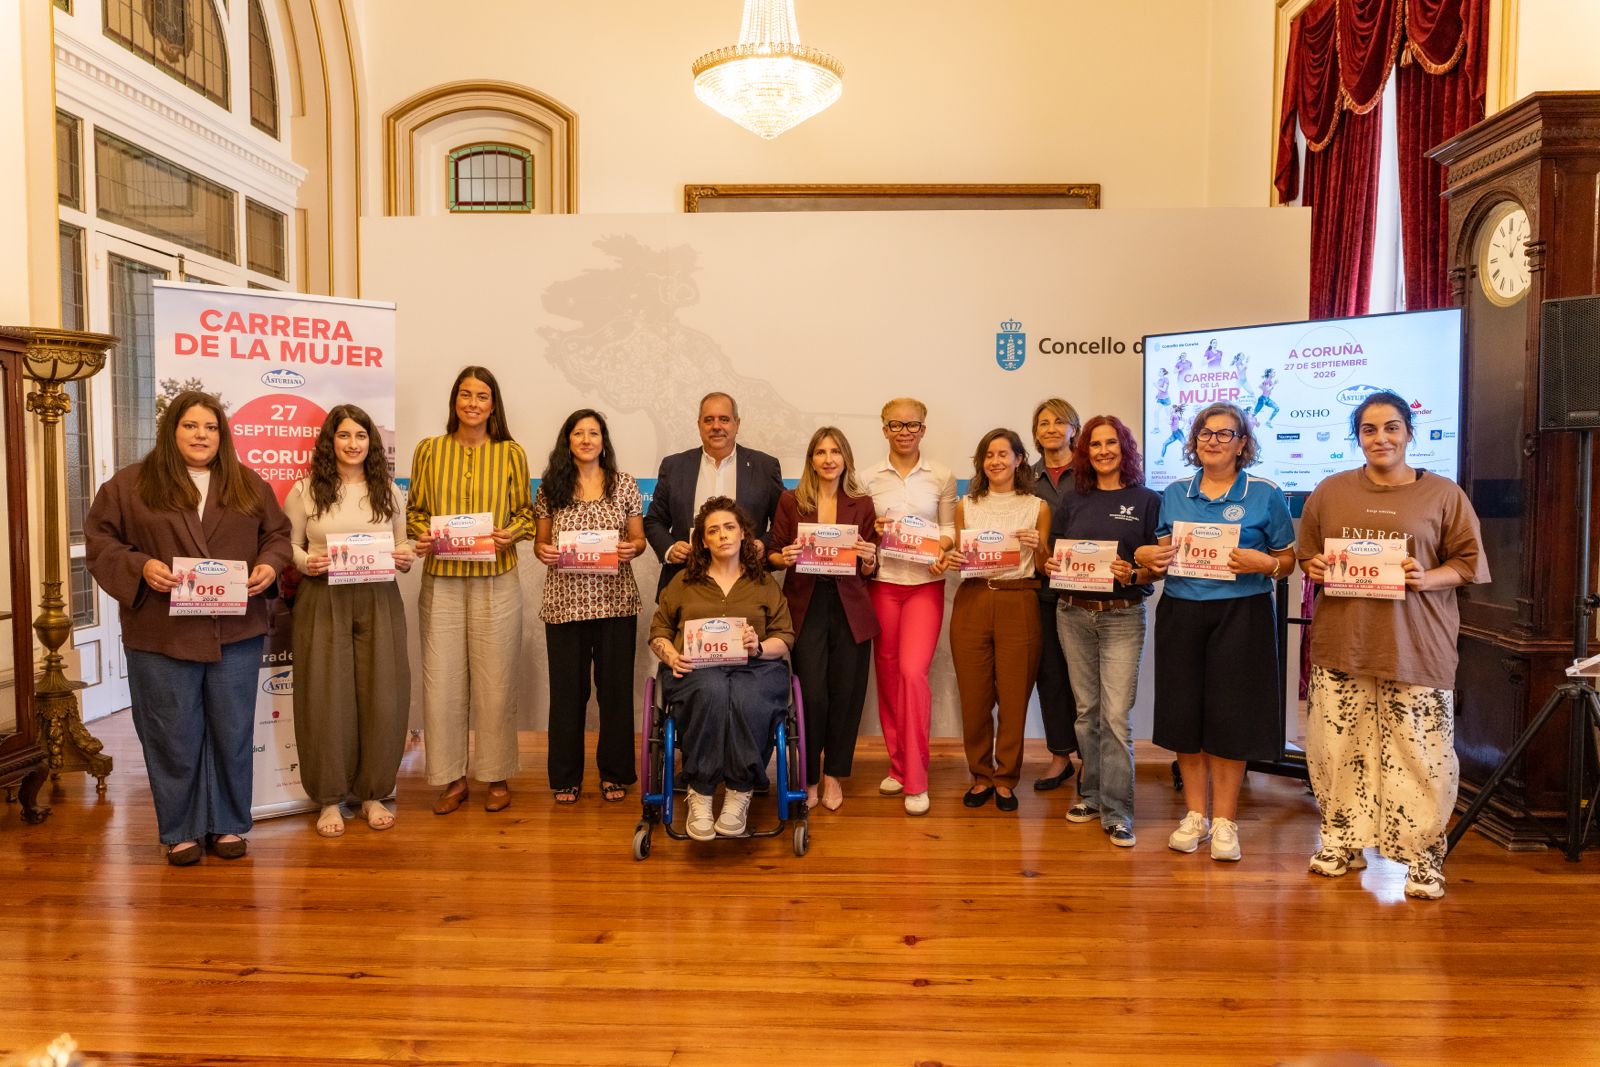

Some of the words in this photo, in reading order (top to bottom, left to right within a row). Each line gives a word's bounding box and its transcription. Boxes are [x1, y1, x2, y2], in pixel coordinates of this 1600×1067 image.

[200, 309, 353, 342] CARRERA
[175, 333, 219, 357] DE
[231, 337, 270, 361] LA
[280, 341, 383, 368] MUJER
[1038, 336, 1126, 354] Concello
[1288, 349, 1298, 359] A
[1302, 342, 1364, 358] CORUÑA
[1284, 363, 1294, 371] 27
[1296, 362, 1309, 370] DE
[1310, 358, 1368, 369] SEPTIEMBRE
[265, 375, 302, 385] ASTURIANA
[1183, 371, 1239, 383] CARRERA
[1313, 370, 1336, 379] 2026
[1179, 387, 1241, 404] MUJER
[1340, 393, 1367, 401] ASTUR
[270, 404, 298, 421] 27
[1290, 408, 1330, 418] OYSHO
[233, 423, 321, 438] SEPTIEMBR
[247, 449, 315, 465] CORU
[1330, 451, 1344, 459] dial
[1341, 526, 1413, 540] ENERGY
[451, 536, 476, 546] 016
[900, 533, 923, 545] 016
[577, 552, 601, 561] 016
[815, 546, 838, 556] 016
[979, 551, 1002, 561] 016
[1191, 547, 1218, 558] 016
[350, 555, 375, 565] 016
[1071, 562, 1096, 573] 016
[1349, 565, 1379, 577] 016
[196, 585, 225, 596] 016
[703, 642, 729, 652] 016
